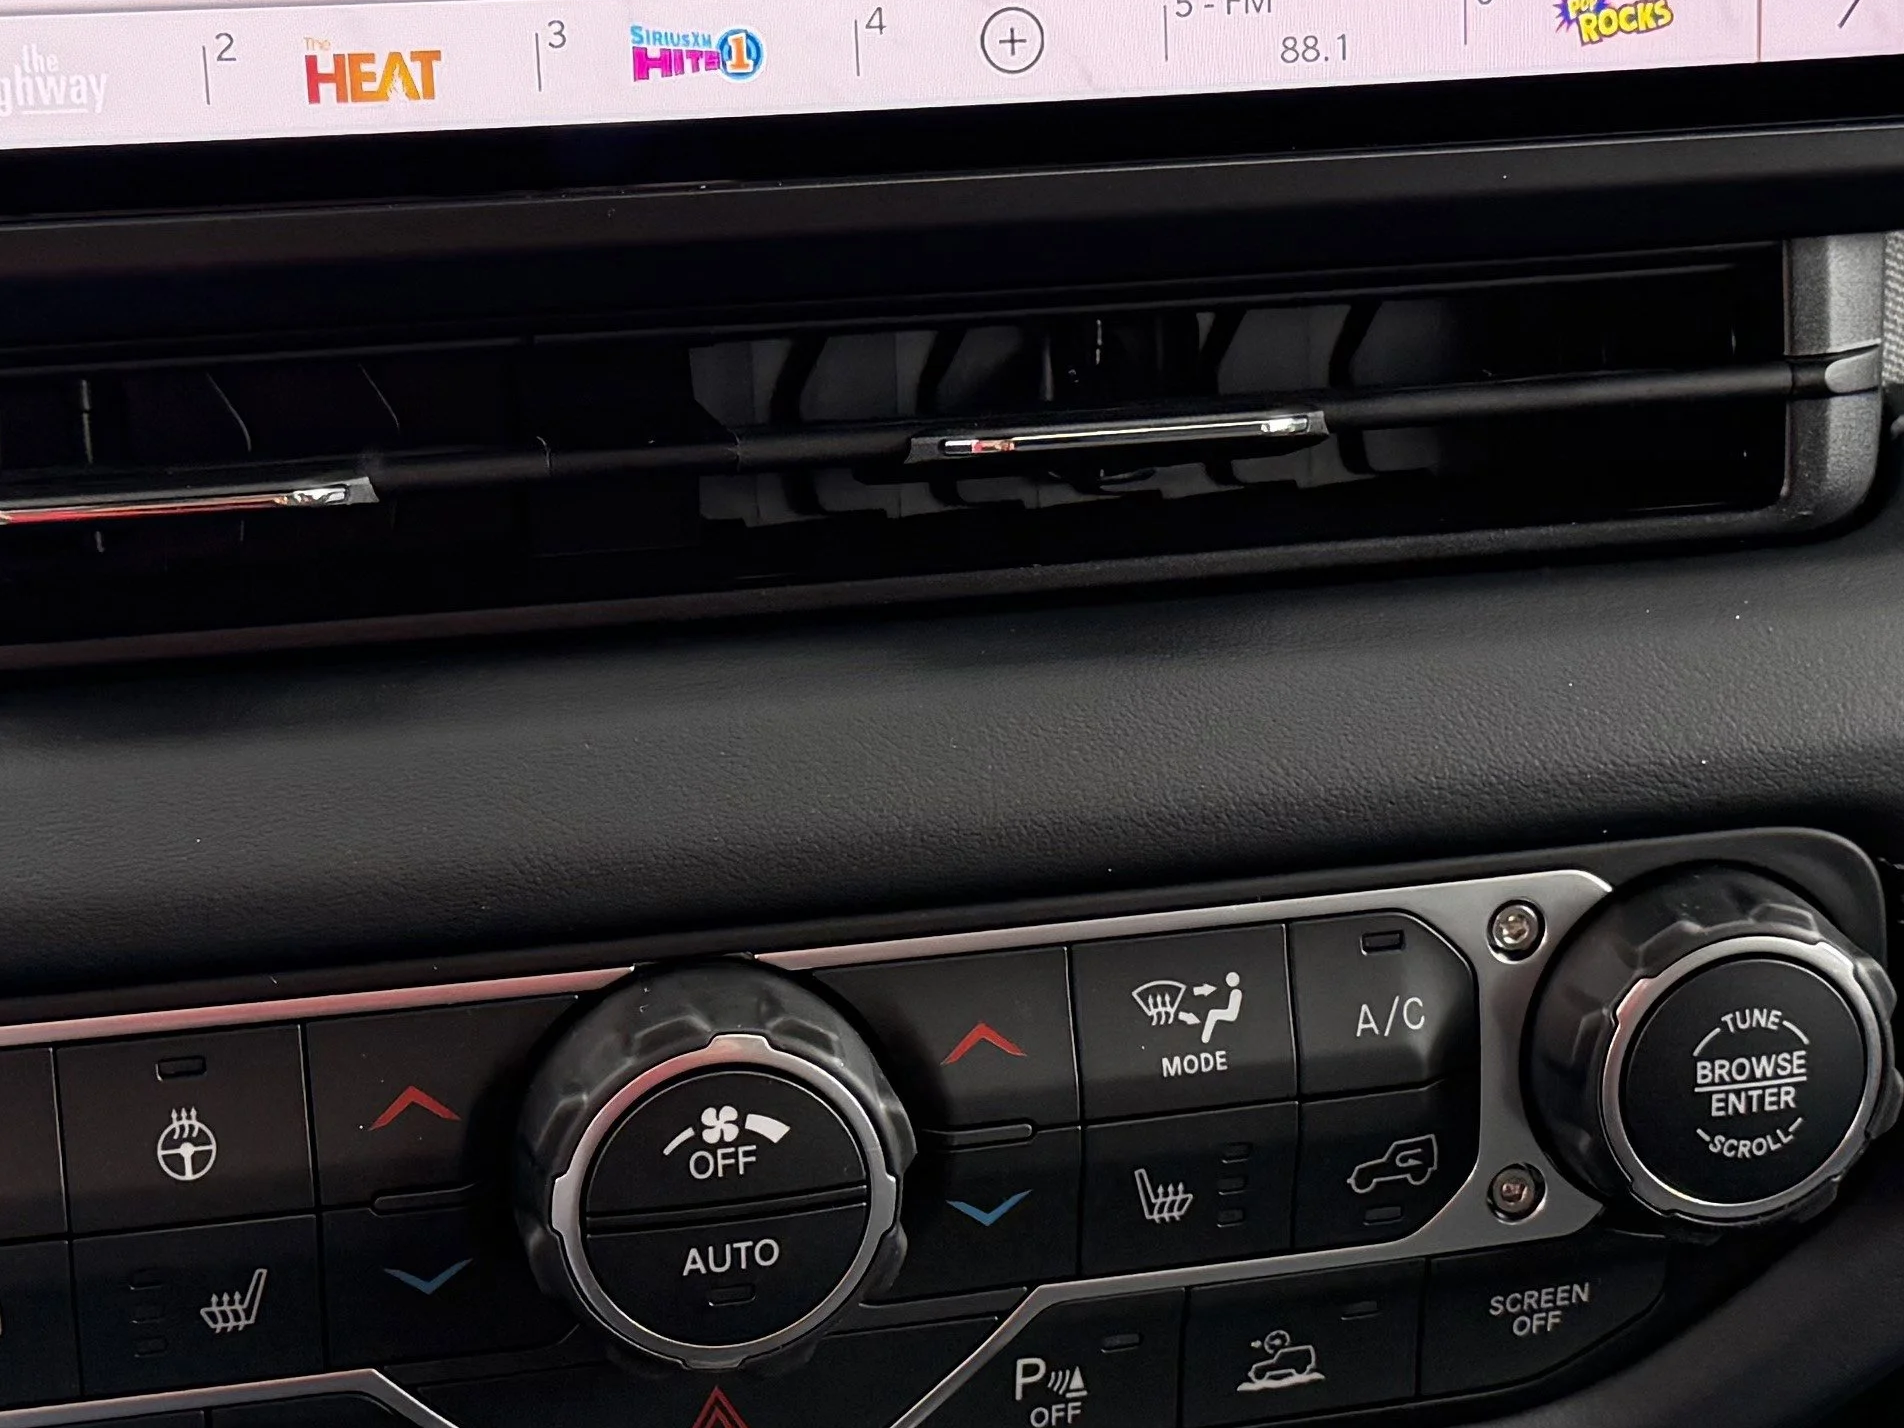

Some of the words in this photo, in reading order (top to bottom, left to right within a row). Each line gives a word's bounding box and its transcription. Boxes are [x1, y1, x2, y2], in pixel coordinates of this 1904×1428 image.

[546, 20, 567, 49] 3
[865, 8, 887, 36] 4
[22, 44, 58, 73] the
[215, 34, 237, 62] 2
[726, 33, 753, 72] 1
[1279, 35, 1348, 66] 88.1
[305, 49, 442, 106] HEAT
[1356, 997, 1426, 1037] A/C
[1722, 1008, 1784, 1038] TUNE
[1162, 1051, 1228, 1077] MODE
[1696, 1050, 1808, 1084] BROWSE
[1710, 1084, 1797, 1116] ENTER
[1707, 1129, 1795, 1160] SCROLL
[689, 1146, 756, 1179] OFF
[683, 1239, 780, 1276] AUTO
[1488, 1282, 1590, 1318] SCREEN
[1512, 1306, 1562, 1337] OFF
[1030, 1402, 1082, 1428] OFF
